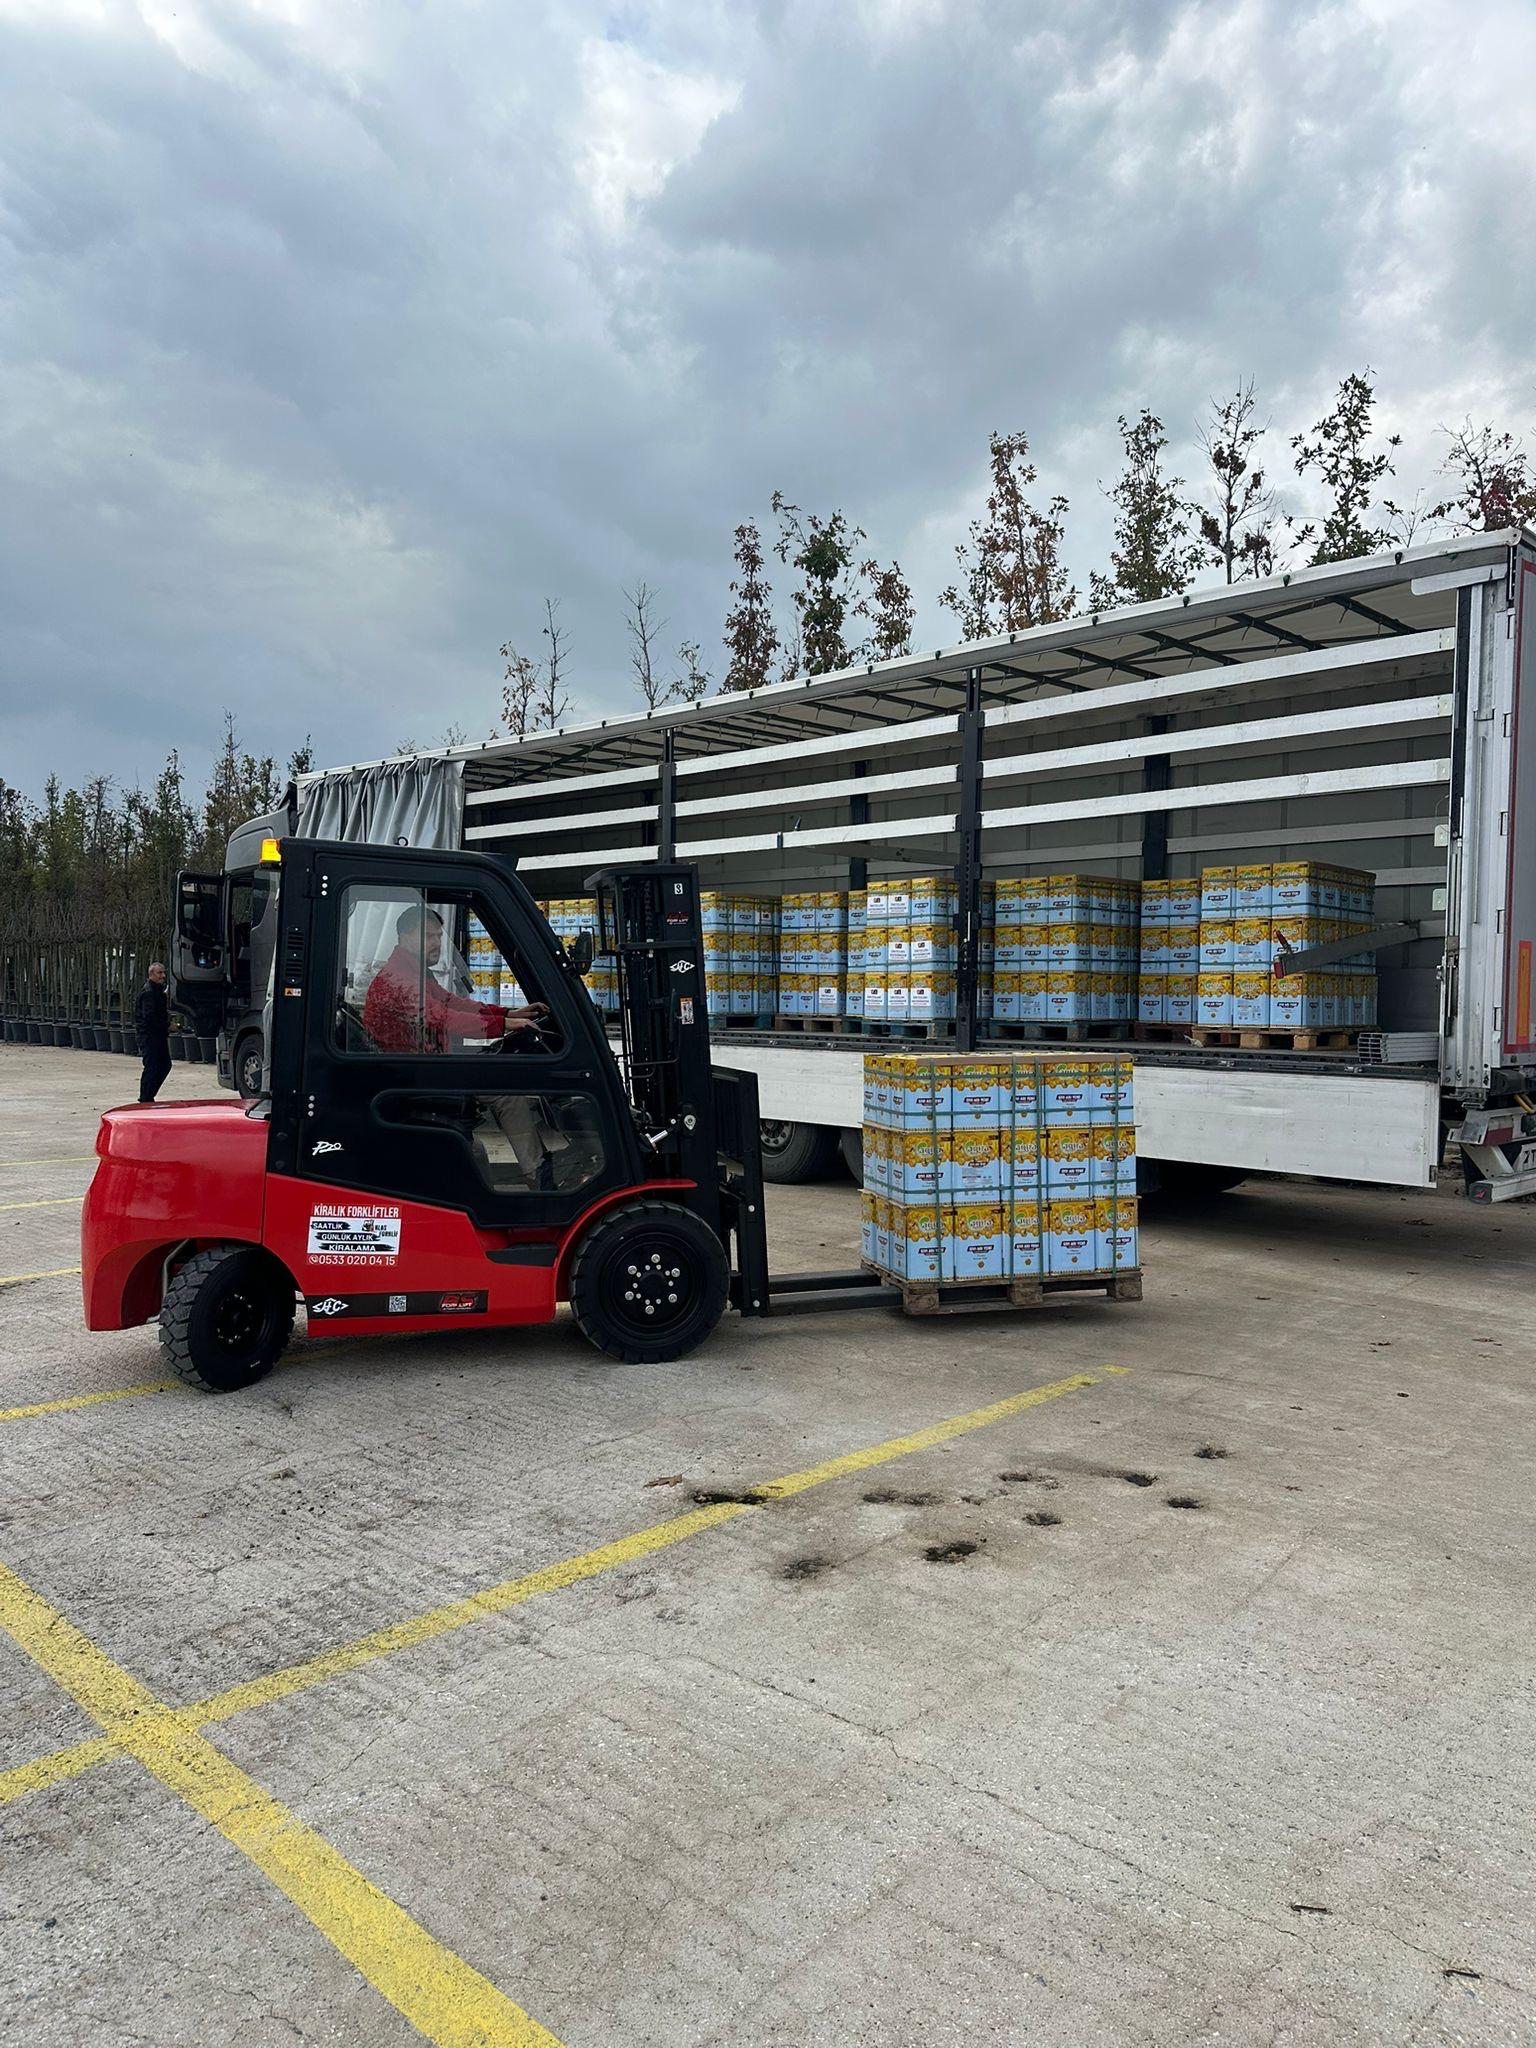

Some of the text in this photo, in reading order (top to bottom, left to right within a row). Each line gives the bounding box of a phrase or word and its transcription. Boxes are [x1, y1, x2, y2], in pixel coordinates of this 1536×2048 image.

[313, 1203, 399, 1218] KİRALIK FORKLİFTLER
[321, 1232, 374, 1241] GÜNLÜK AYLIK
[328, 1244, 376, 1252] KİRALAMA
[319, 1254, 396, 1266] 0533 020 04 15
